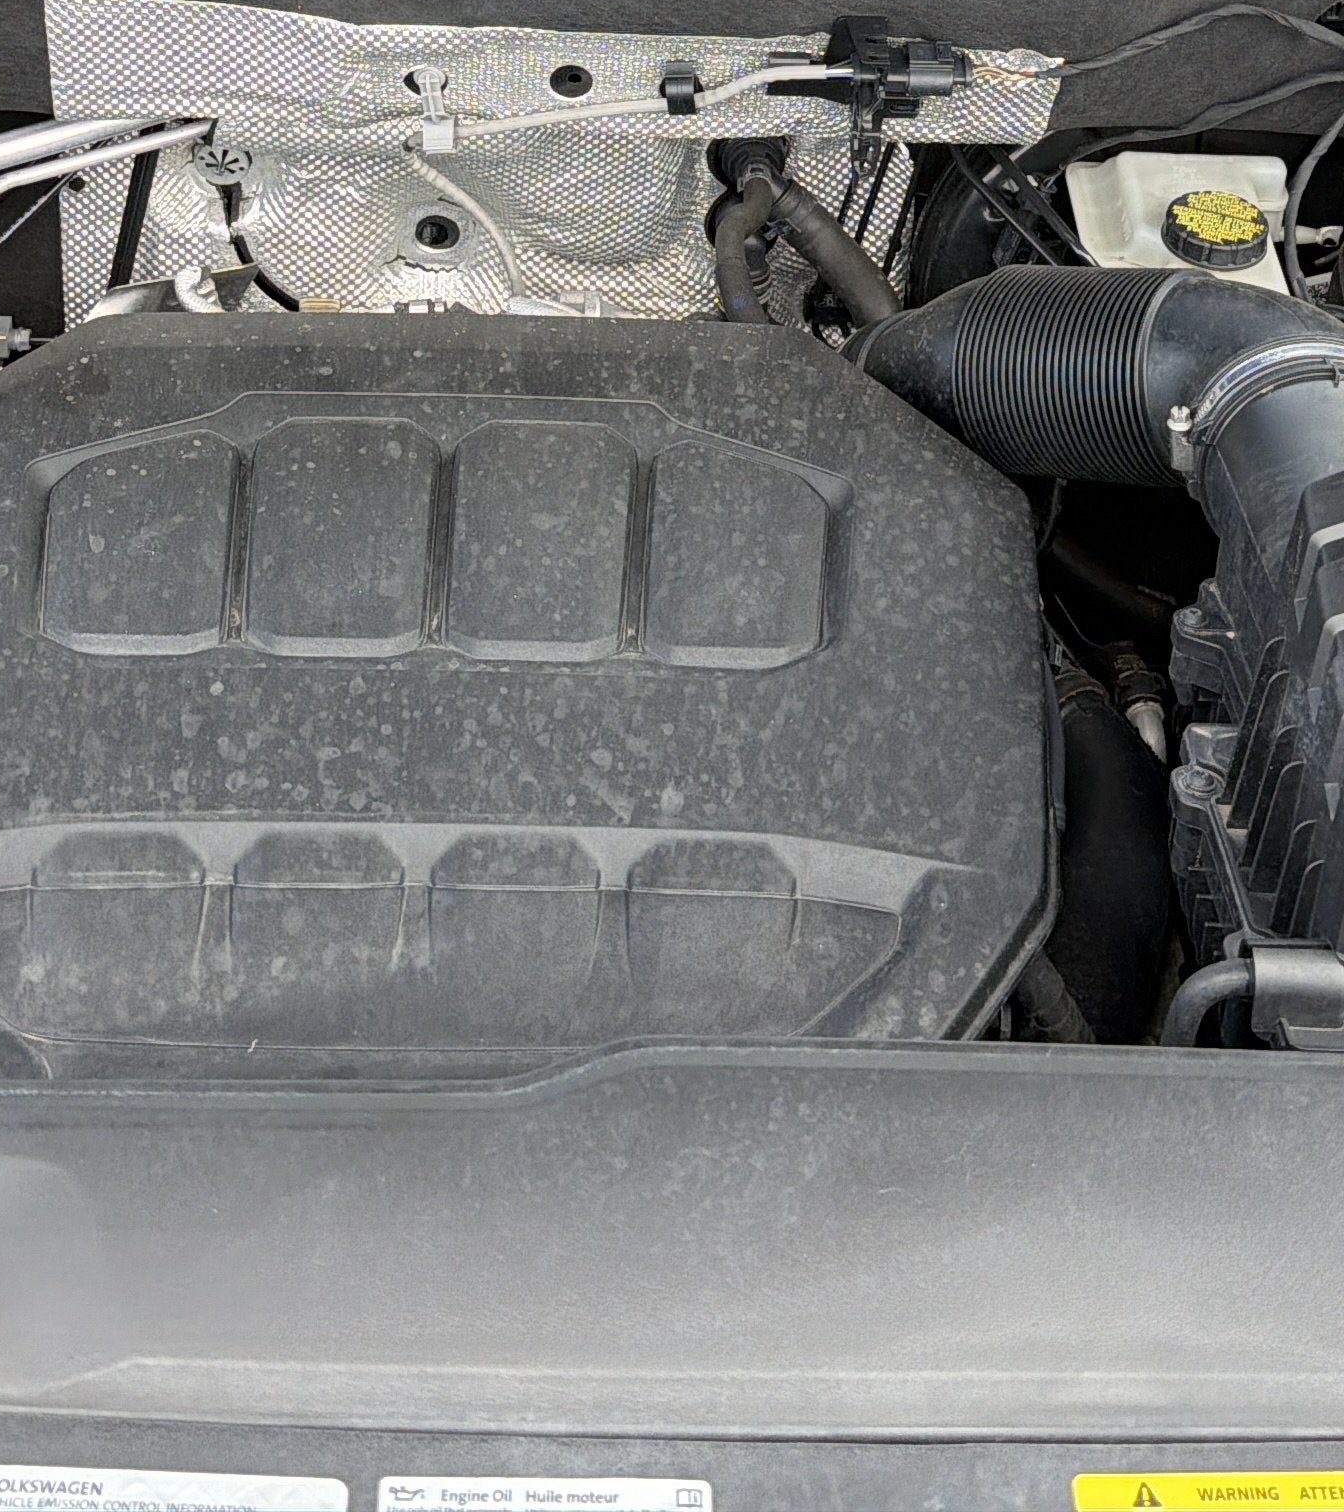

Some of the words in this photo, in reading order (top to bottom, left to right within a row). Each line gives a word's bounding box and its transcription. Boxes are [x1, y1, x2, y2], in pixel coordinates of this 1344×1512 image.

[440, 1489, 488, 1505] Engine
[492, 1489, 513, 1502] Oil
[525, 1490, 562, 1503] Huile
[567, 1491, 620, 1503] moteur
[1197, 1487, 1280, 1501] WARNING
[36, 1496, 100, 1510] EMISSION
[103, 1500, 161, 1512] CONTROL
